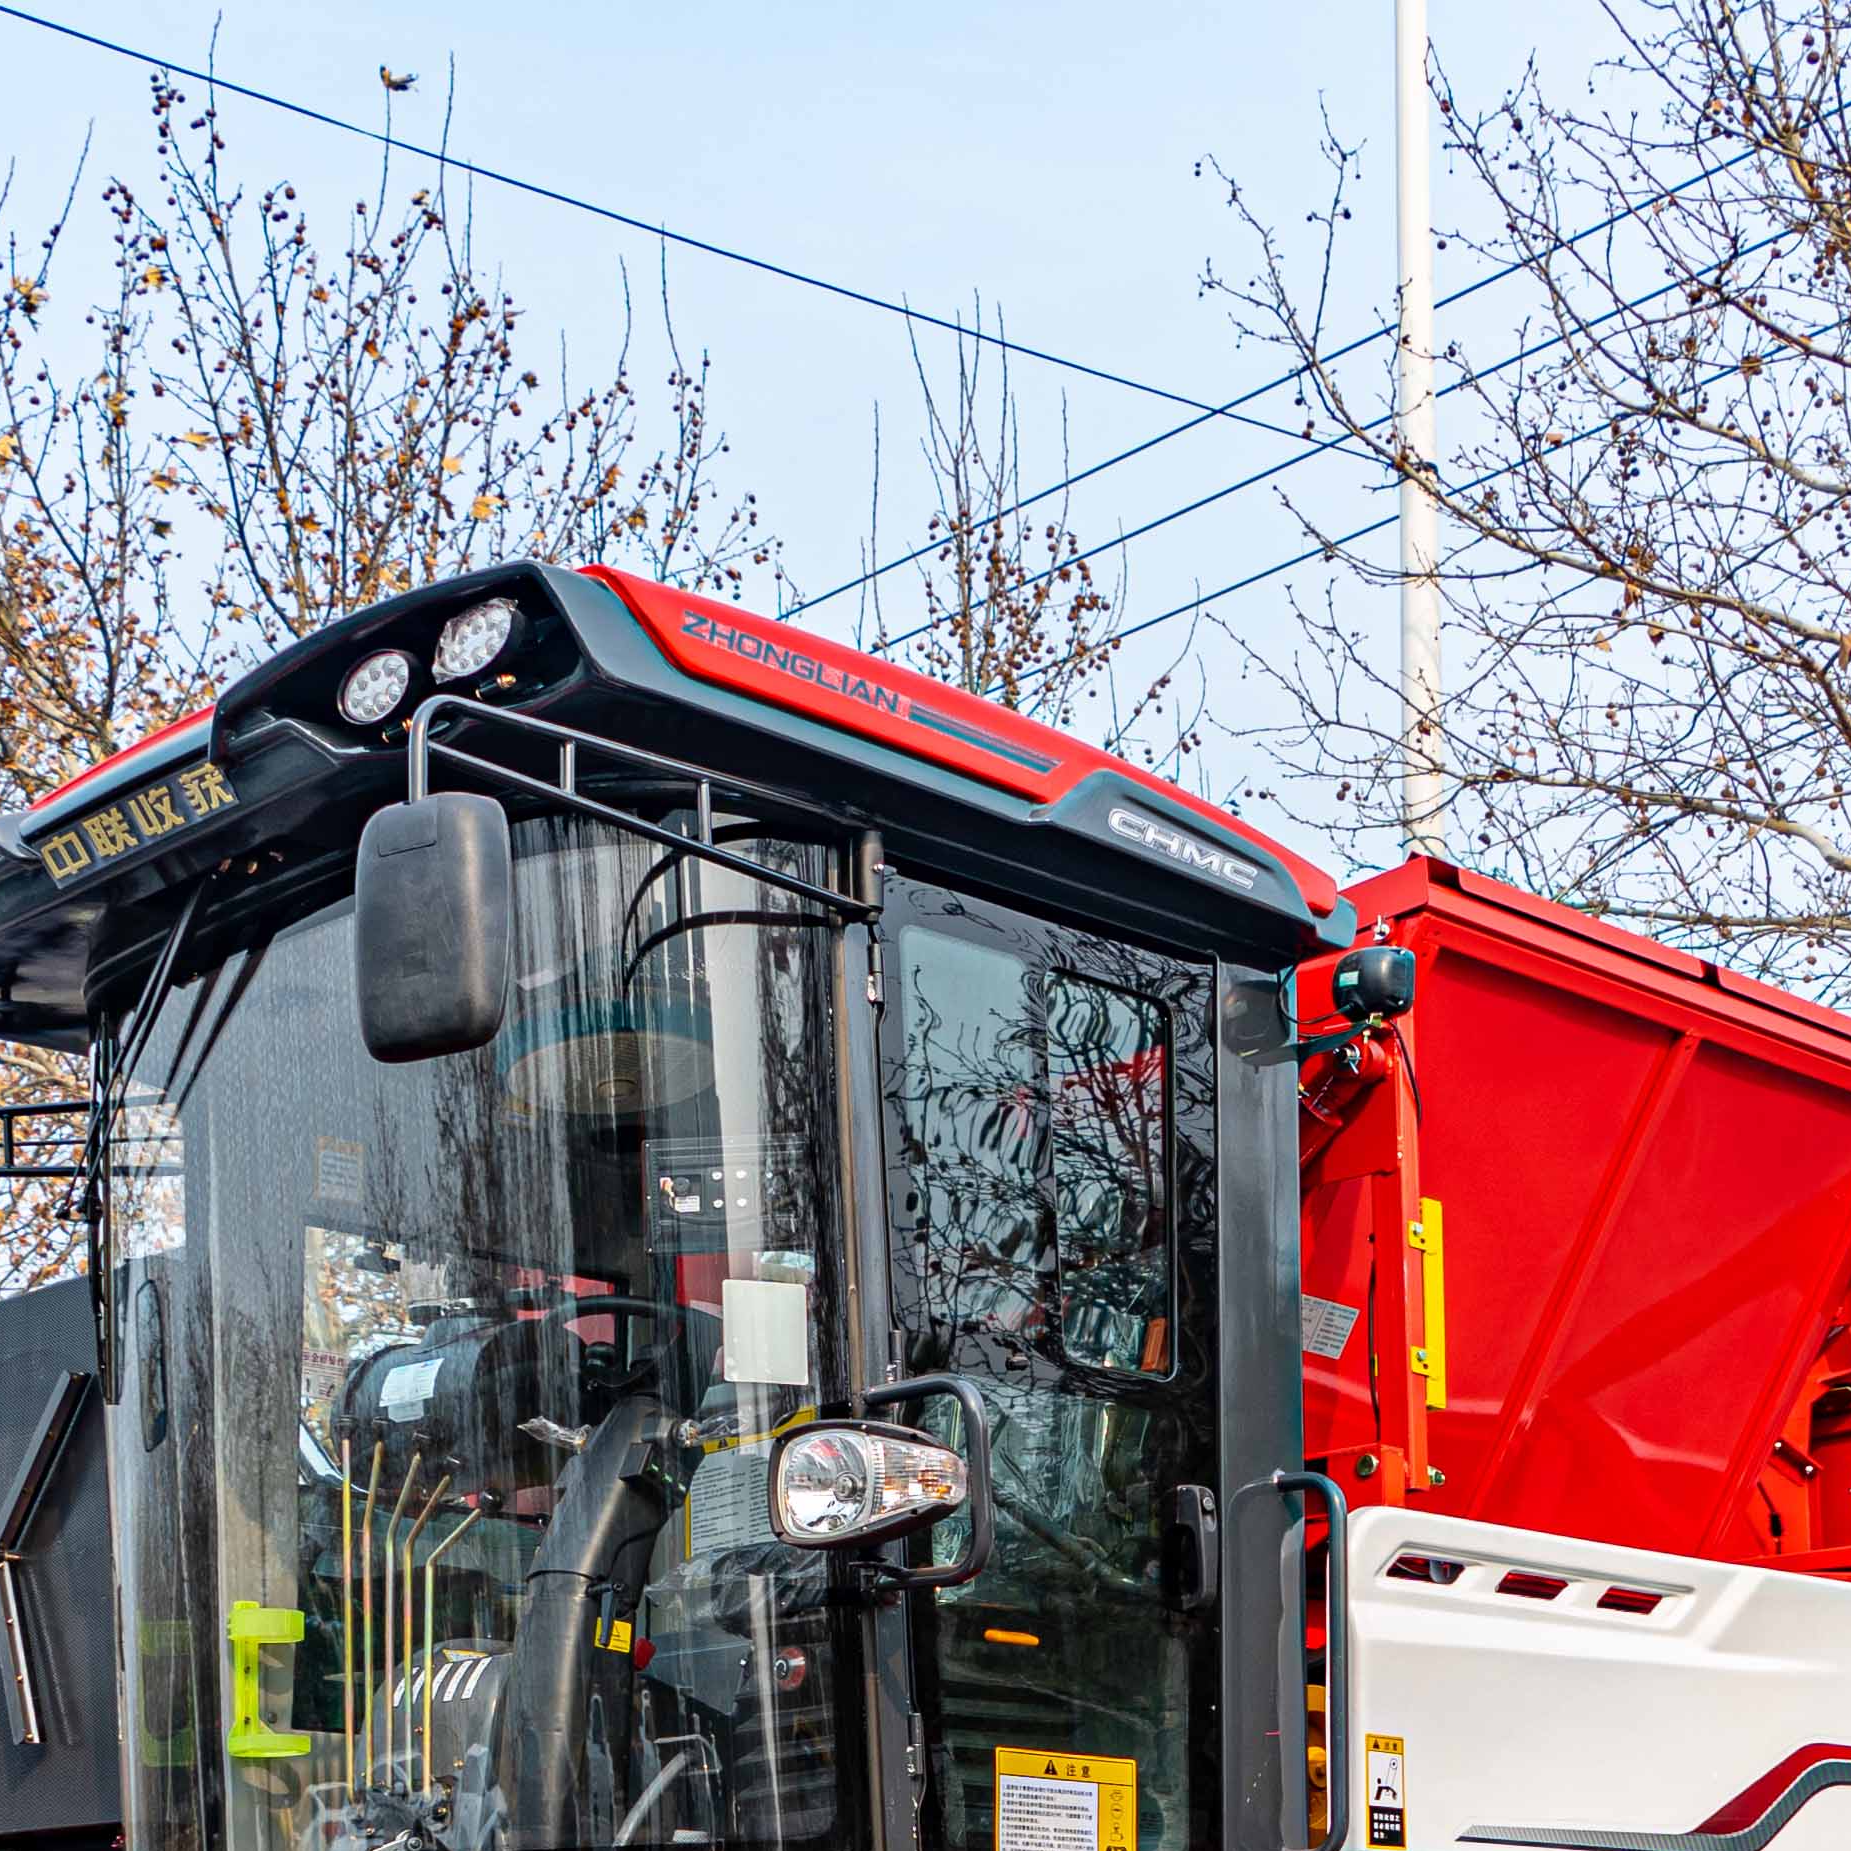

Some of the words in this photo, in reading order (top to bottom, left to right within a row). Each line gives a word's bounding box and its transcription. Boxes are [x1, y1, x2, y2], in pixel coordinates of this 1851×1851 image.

[681, 609, 899, 714] ZHONGLIAN
[41, 762, 235, 880] 中联收获
[1108, 808, 1259, 890] CHMC
